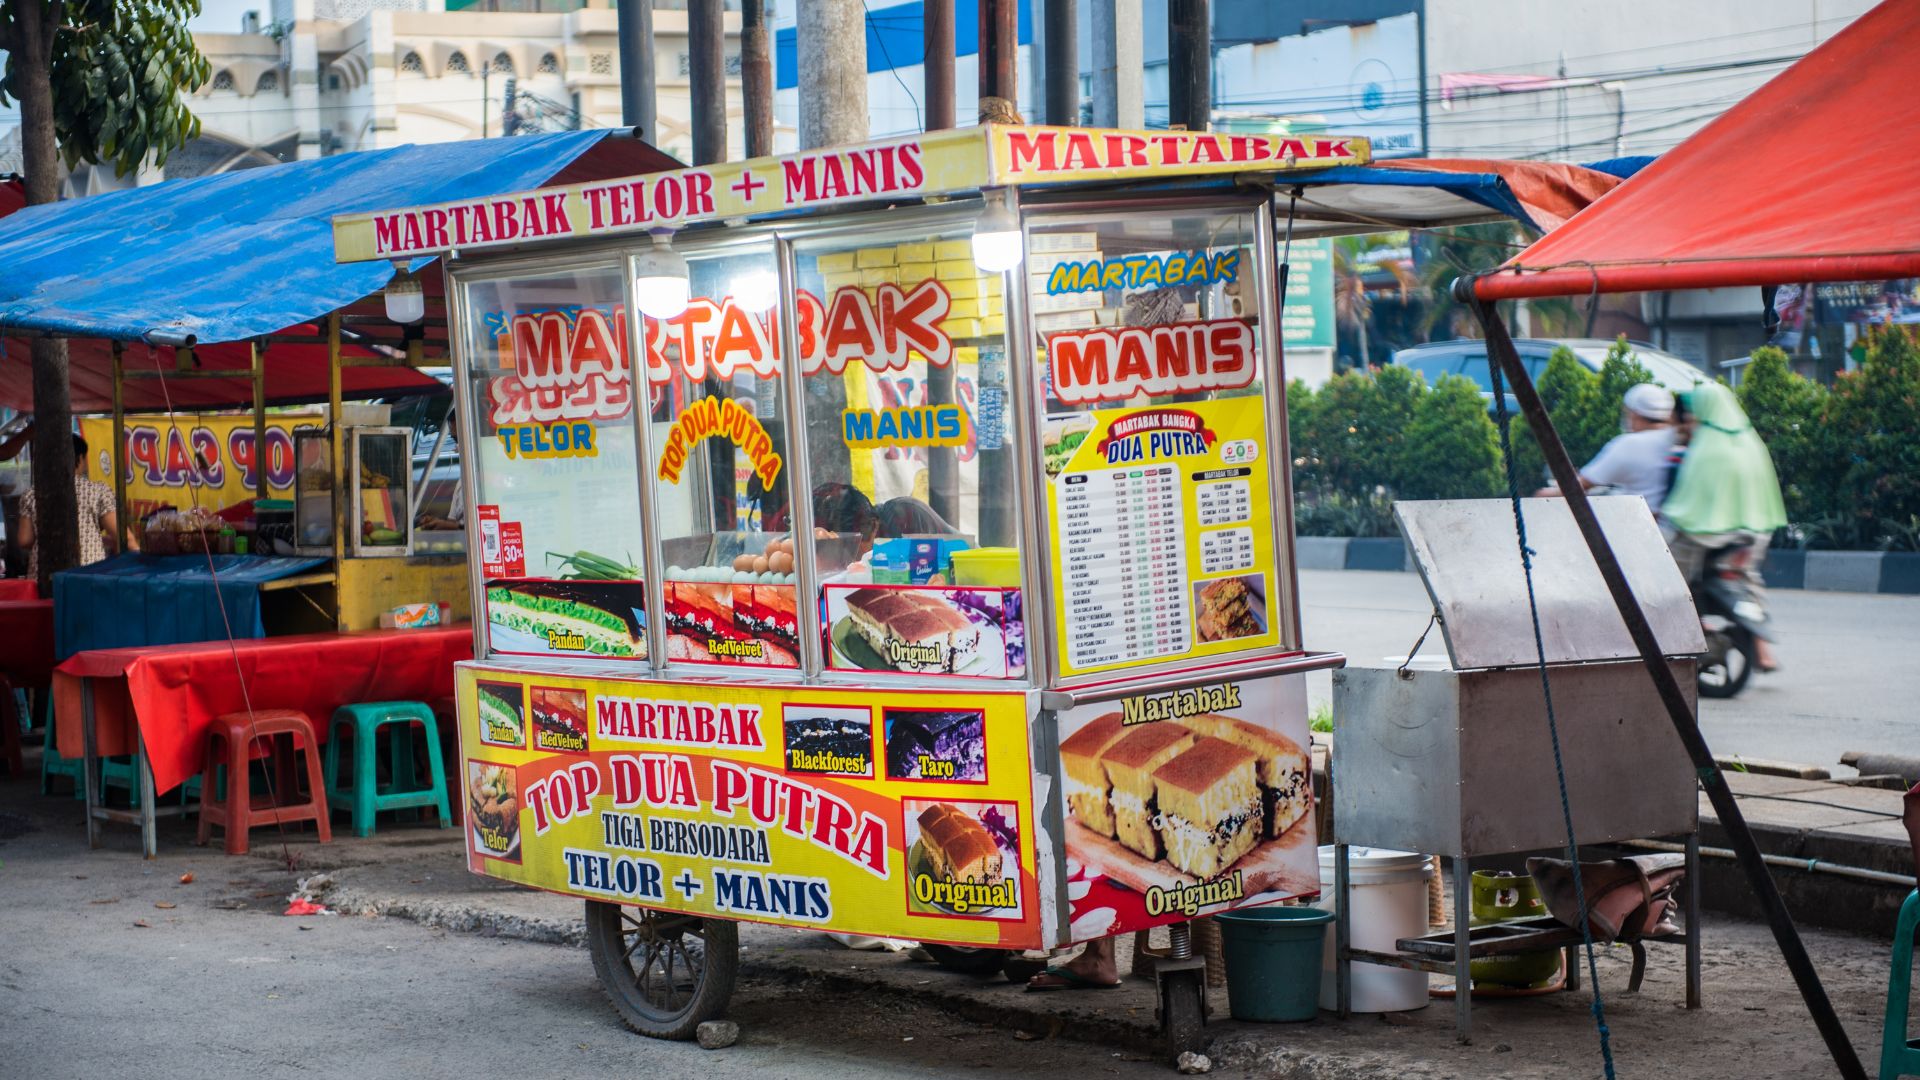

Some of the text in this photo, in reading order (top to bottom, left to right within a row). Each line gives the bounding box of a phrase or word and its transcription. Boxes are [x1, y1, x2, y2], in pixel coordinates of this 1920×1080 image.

[1007, 132, 1356, 172] MARTABAK
[374, 142, 923, 254] MARTABAK TELOR + MANIS
[1049, 252, 1237, 293] MARTABAK
[1816, 283, 1881, 298] SIGNATURE
[514, 279, 950, 385] MARTABAK
[1053, 322, 1253, 399] MANIS
[497, 422, 595, 456] TELOR
[844, 408, 964, 443] MANIS
[1114, 413, 1196, 437] MARTABAK BANGKA
[660, 396, 781, 491] TOP DUA PUTRA
[1107, 436, 1143, 464] DUA
[1150, 430, 1208, 458] PUTRA
[504, 546, 524, 563] 30%
[547, 630, 585, 651] Pandan
[708, 639, 761, 657] RedVelvet
[890, 640, 941, 667] Original
[1121, 683, 1242, 725] Martabak
[488, 721, 515, 743] Pandan
[597, 699, 763, 747] MARTABAK
[541, 731, 584, 751] RedVelvet
[791, 749, 866, 773] Blackforest
[918, 755, 954, 777] Taro
[527, 759, 887, 876] TOP DUA PUTRA
[482, 827, 508, 851] Telor
[602, 813, 770, 864] TIGA BERSODARA
[565, 851, 830, 919] TELOR + MANIS
[915, 874, 1018, 912] Original
[1145, 872, 1243, 917] Original
